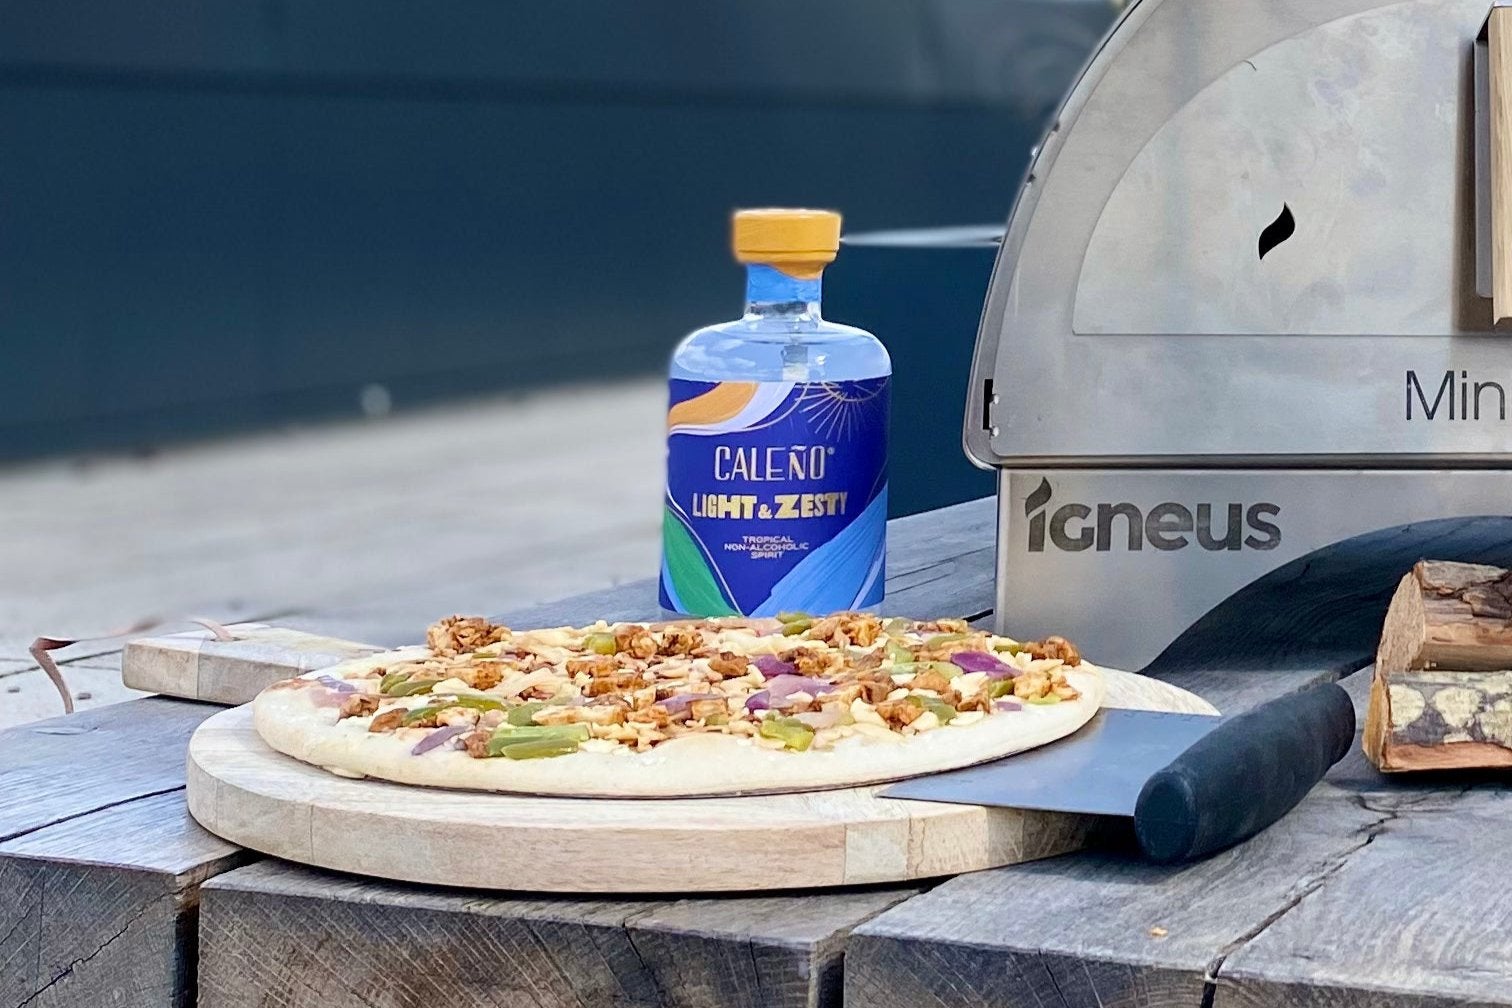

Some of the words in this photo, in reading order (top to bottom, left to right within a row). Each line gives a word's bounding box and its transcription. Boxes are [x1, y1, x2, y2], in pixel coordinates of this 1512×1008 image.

[742, 535, 794, 544] TROPICAL
[723, 542, 809, 551] NON-ALCOHOLIC
[750, 551, 784, 560] SPIRIT
